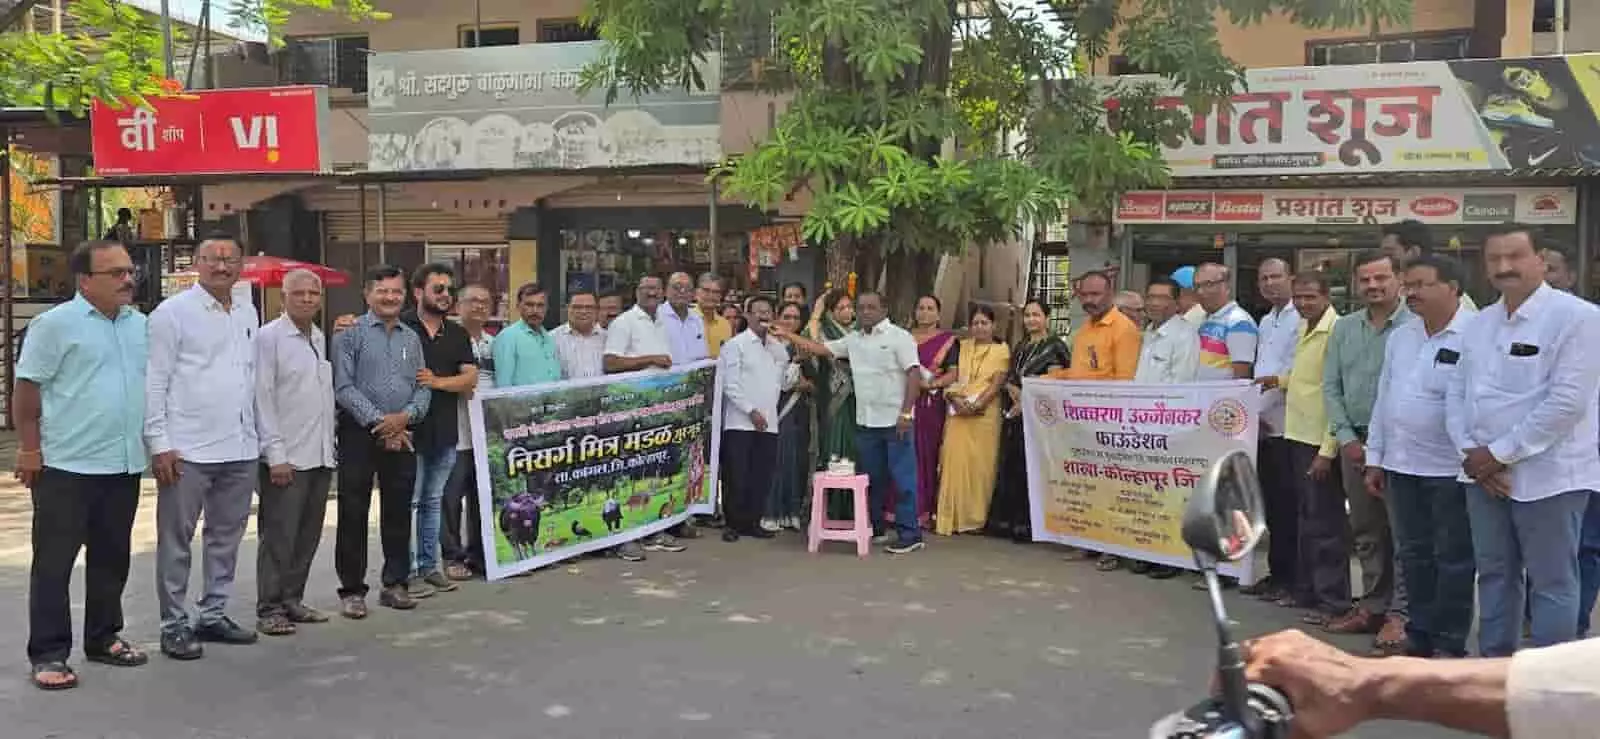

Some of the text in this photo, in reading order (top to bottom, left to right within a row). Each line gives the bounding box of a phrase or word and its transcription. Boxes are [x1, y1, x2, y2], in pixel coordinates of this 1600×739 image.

[1303, 85, 1443, 168] शूज
[1274, 193, 1345, 217] प्रशांत
[1063, 399, 1123, 423] शिवचरण
[507, 436, 576, 478] निसर्ग
[579, 434, 620, 463] मित्र
